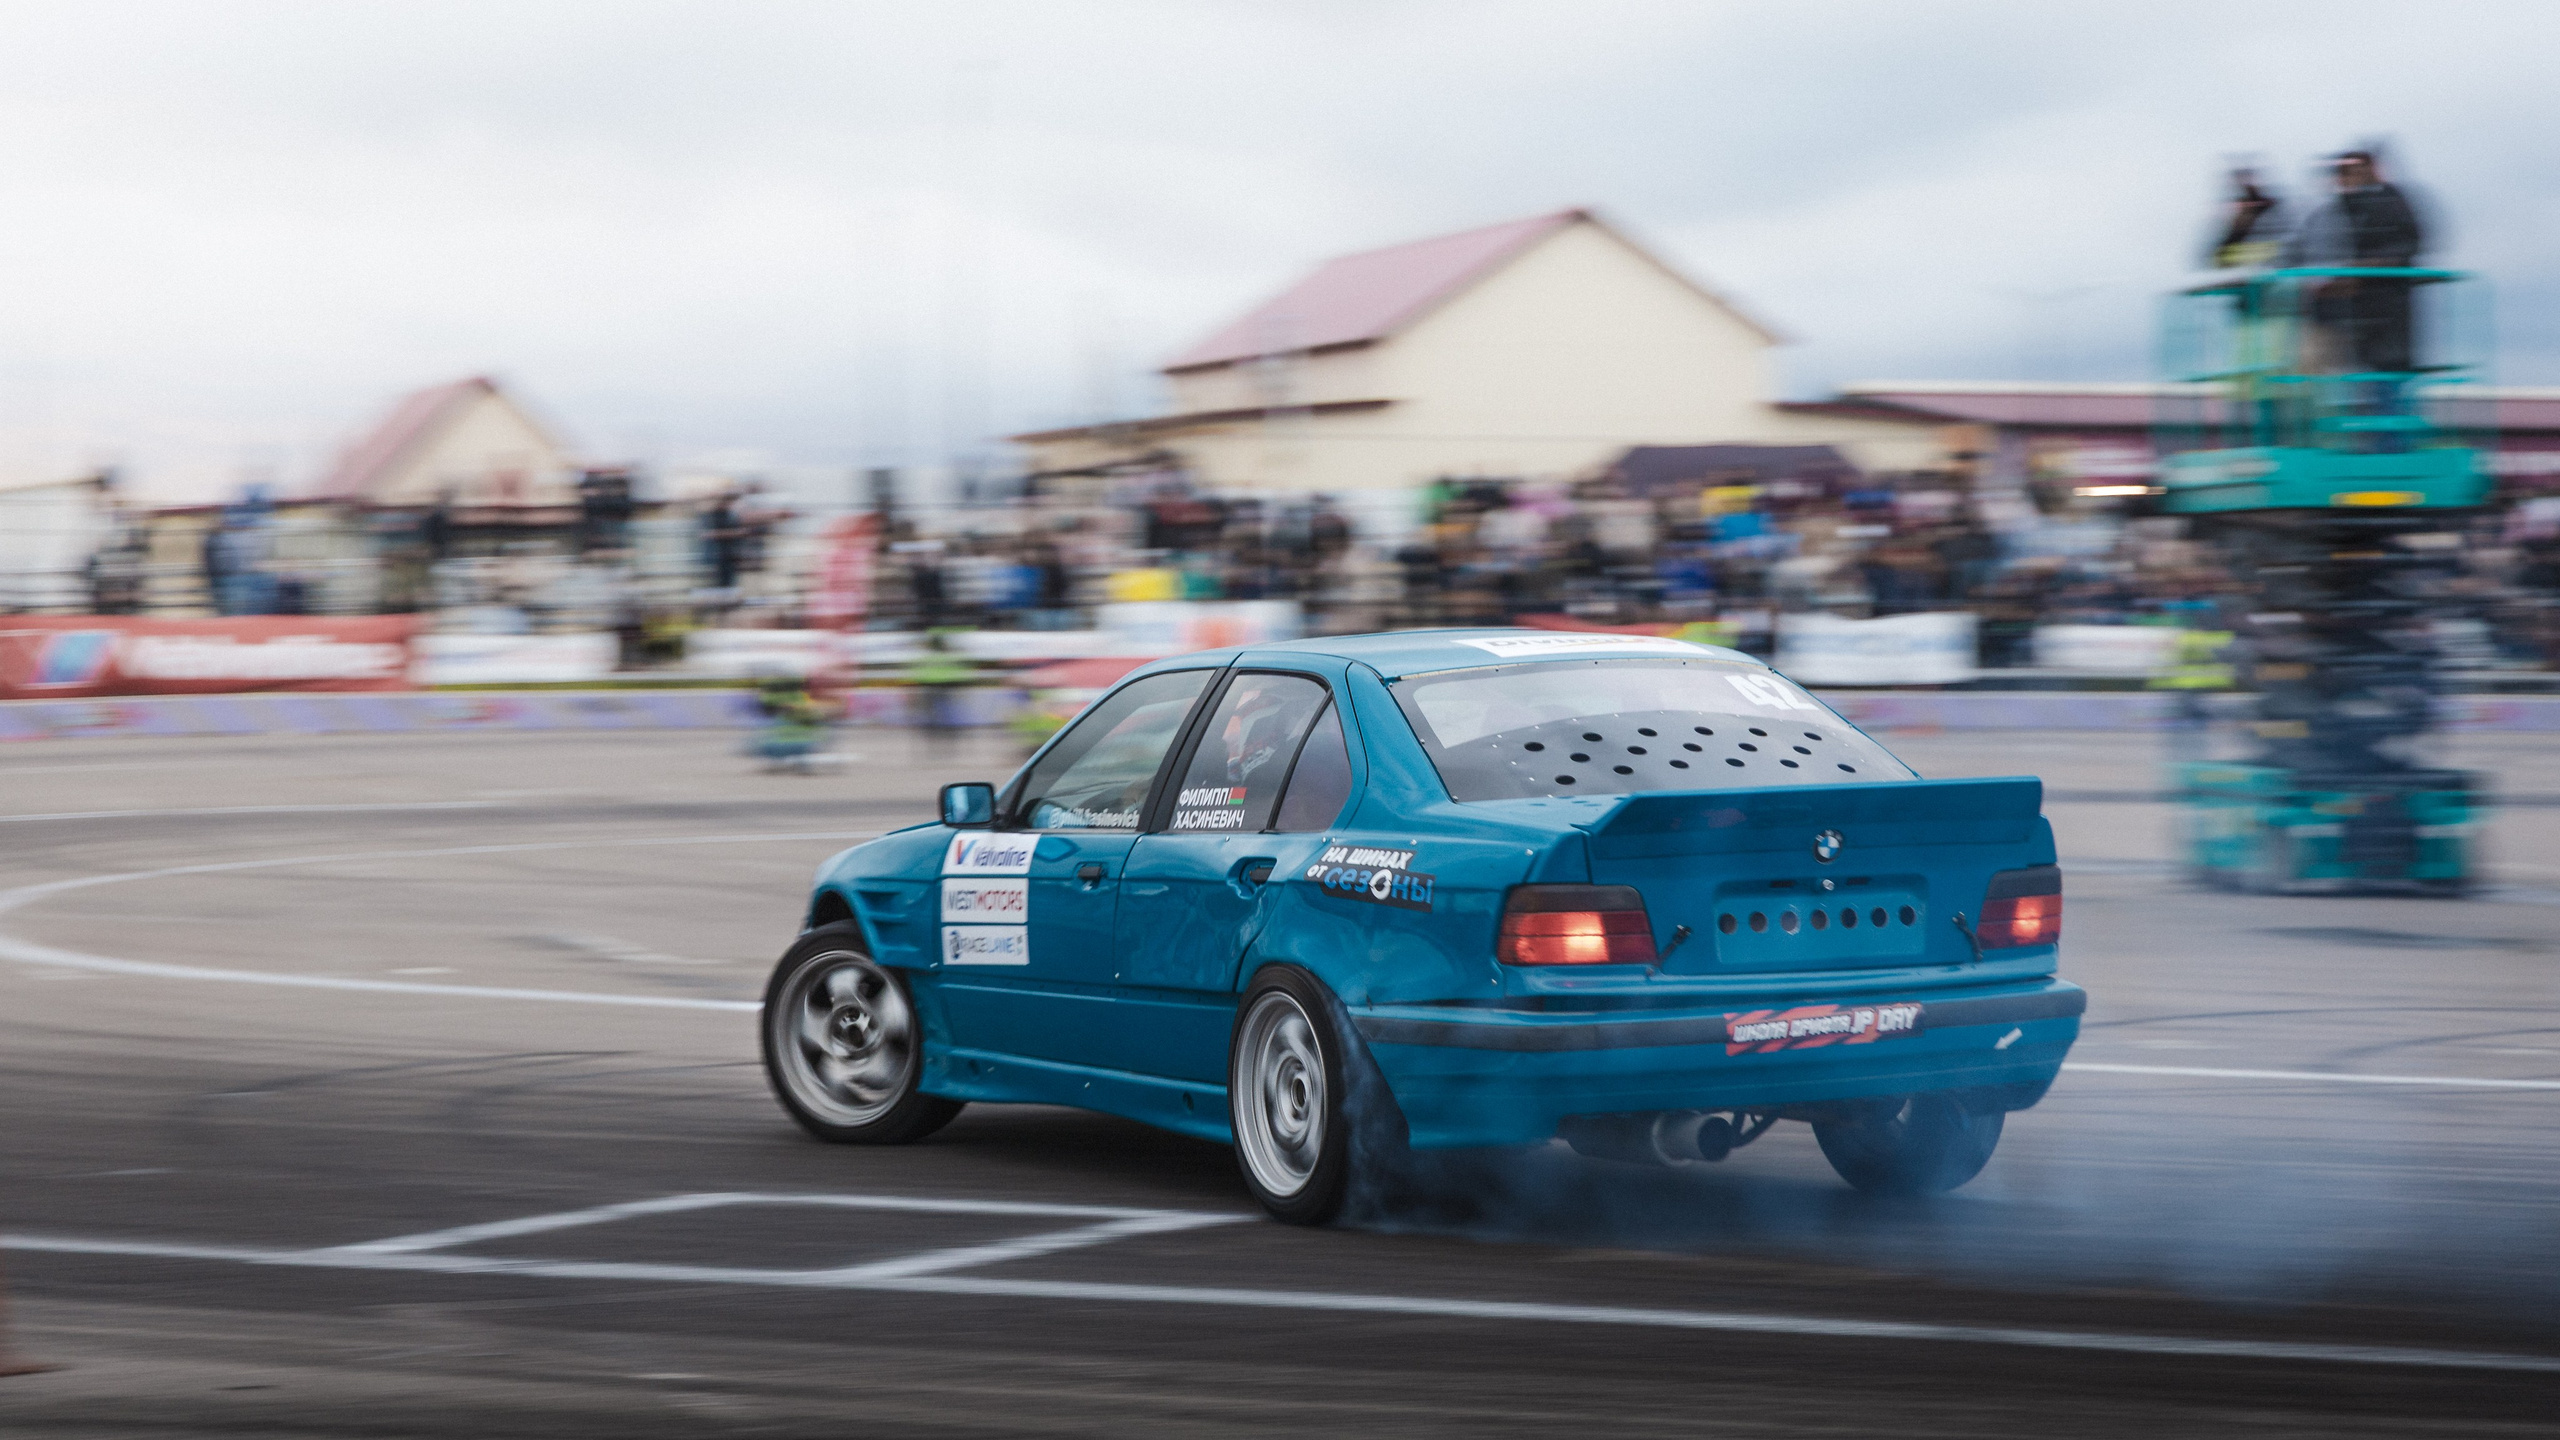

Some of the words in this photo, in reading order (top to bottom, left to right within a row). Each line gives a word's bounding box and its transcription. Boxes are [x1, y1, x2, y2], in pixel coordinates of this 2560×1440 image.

[1723, 673, 1819, 710] 42
[1179, 787, 1229, 806] ФИЛИПП
[1174, 810, 1245, 829] ХАСИНЕВИЧ
[974, 846, 1027, 867] Valvoline
[1321, 847, 1348, 863] НА
[1346, 848, 1413, 870] ШИНАХ
[1850, 1009, 1874, 1034] JP
